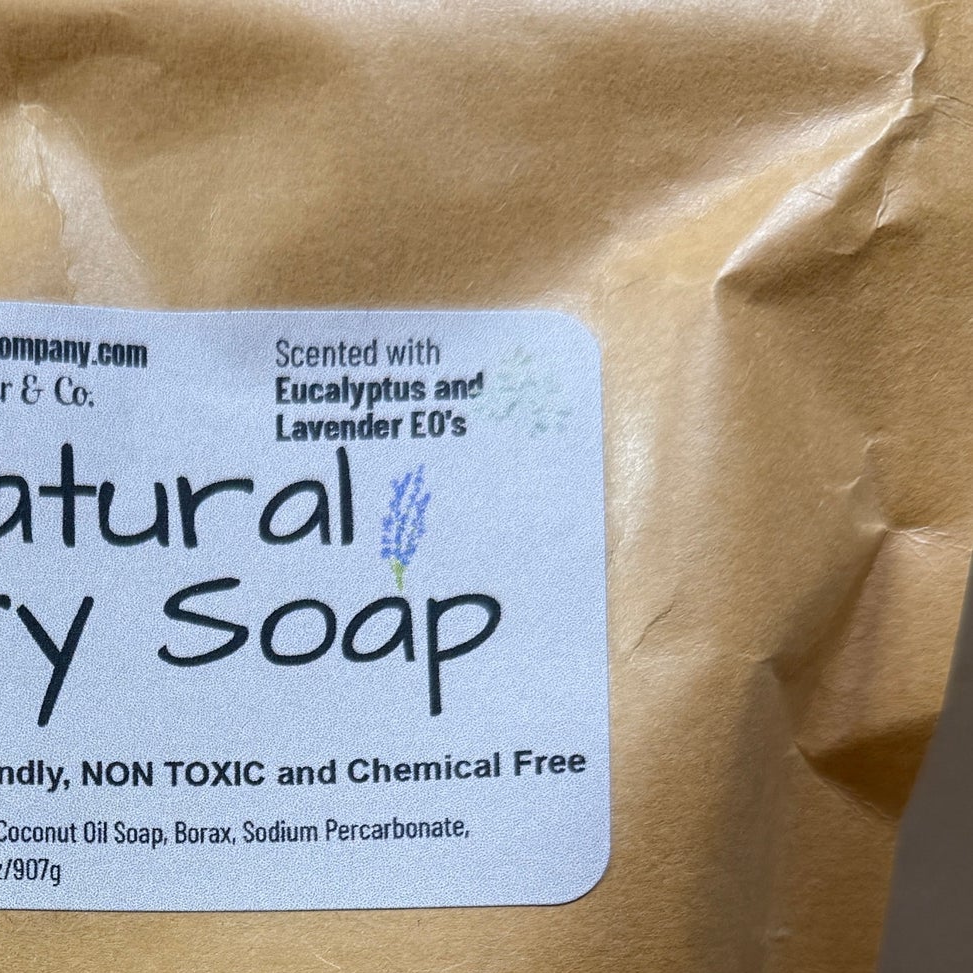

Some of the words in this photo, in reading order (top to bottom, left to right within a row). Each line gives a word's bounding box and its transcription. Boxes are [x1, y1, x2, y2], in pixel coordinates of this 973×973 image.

[277, 340, 377, 367] Scented
[387, 338, 440, 366] with
[21, 375, 44, 404] &
[276, 376, 426, 410] Eucalyptus
[434, 372, 484, 399] and
[277, 413, 402, 441] Lavender
[411, 410, 466, 438] EO's
[158, 577, 500, 716] Soap
[81, 760, 154, 787] NON
[164, 760, 265, 786] TOXIC
[278, 758, 337, 785] and
[348, 752, 501, 783] Chemical
[514, 750, 586, 776] Free
[84, 820, 108, 843] Oil
[114, 821, 168, 850] Soap,
[175, 819, 236, 845] Borax,
[243, 818, 318, 842] Sodium
[326, 816, 471, 842] Percarbonate,
